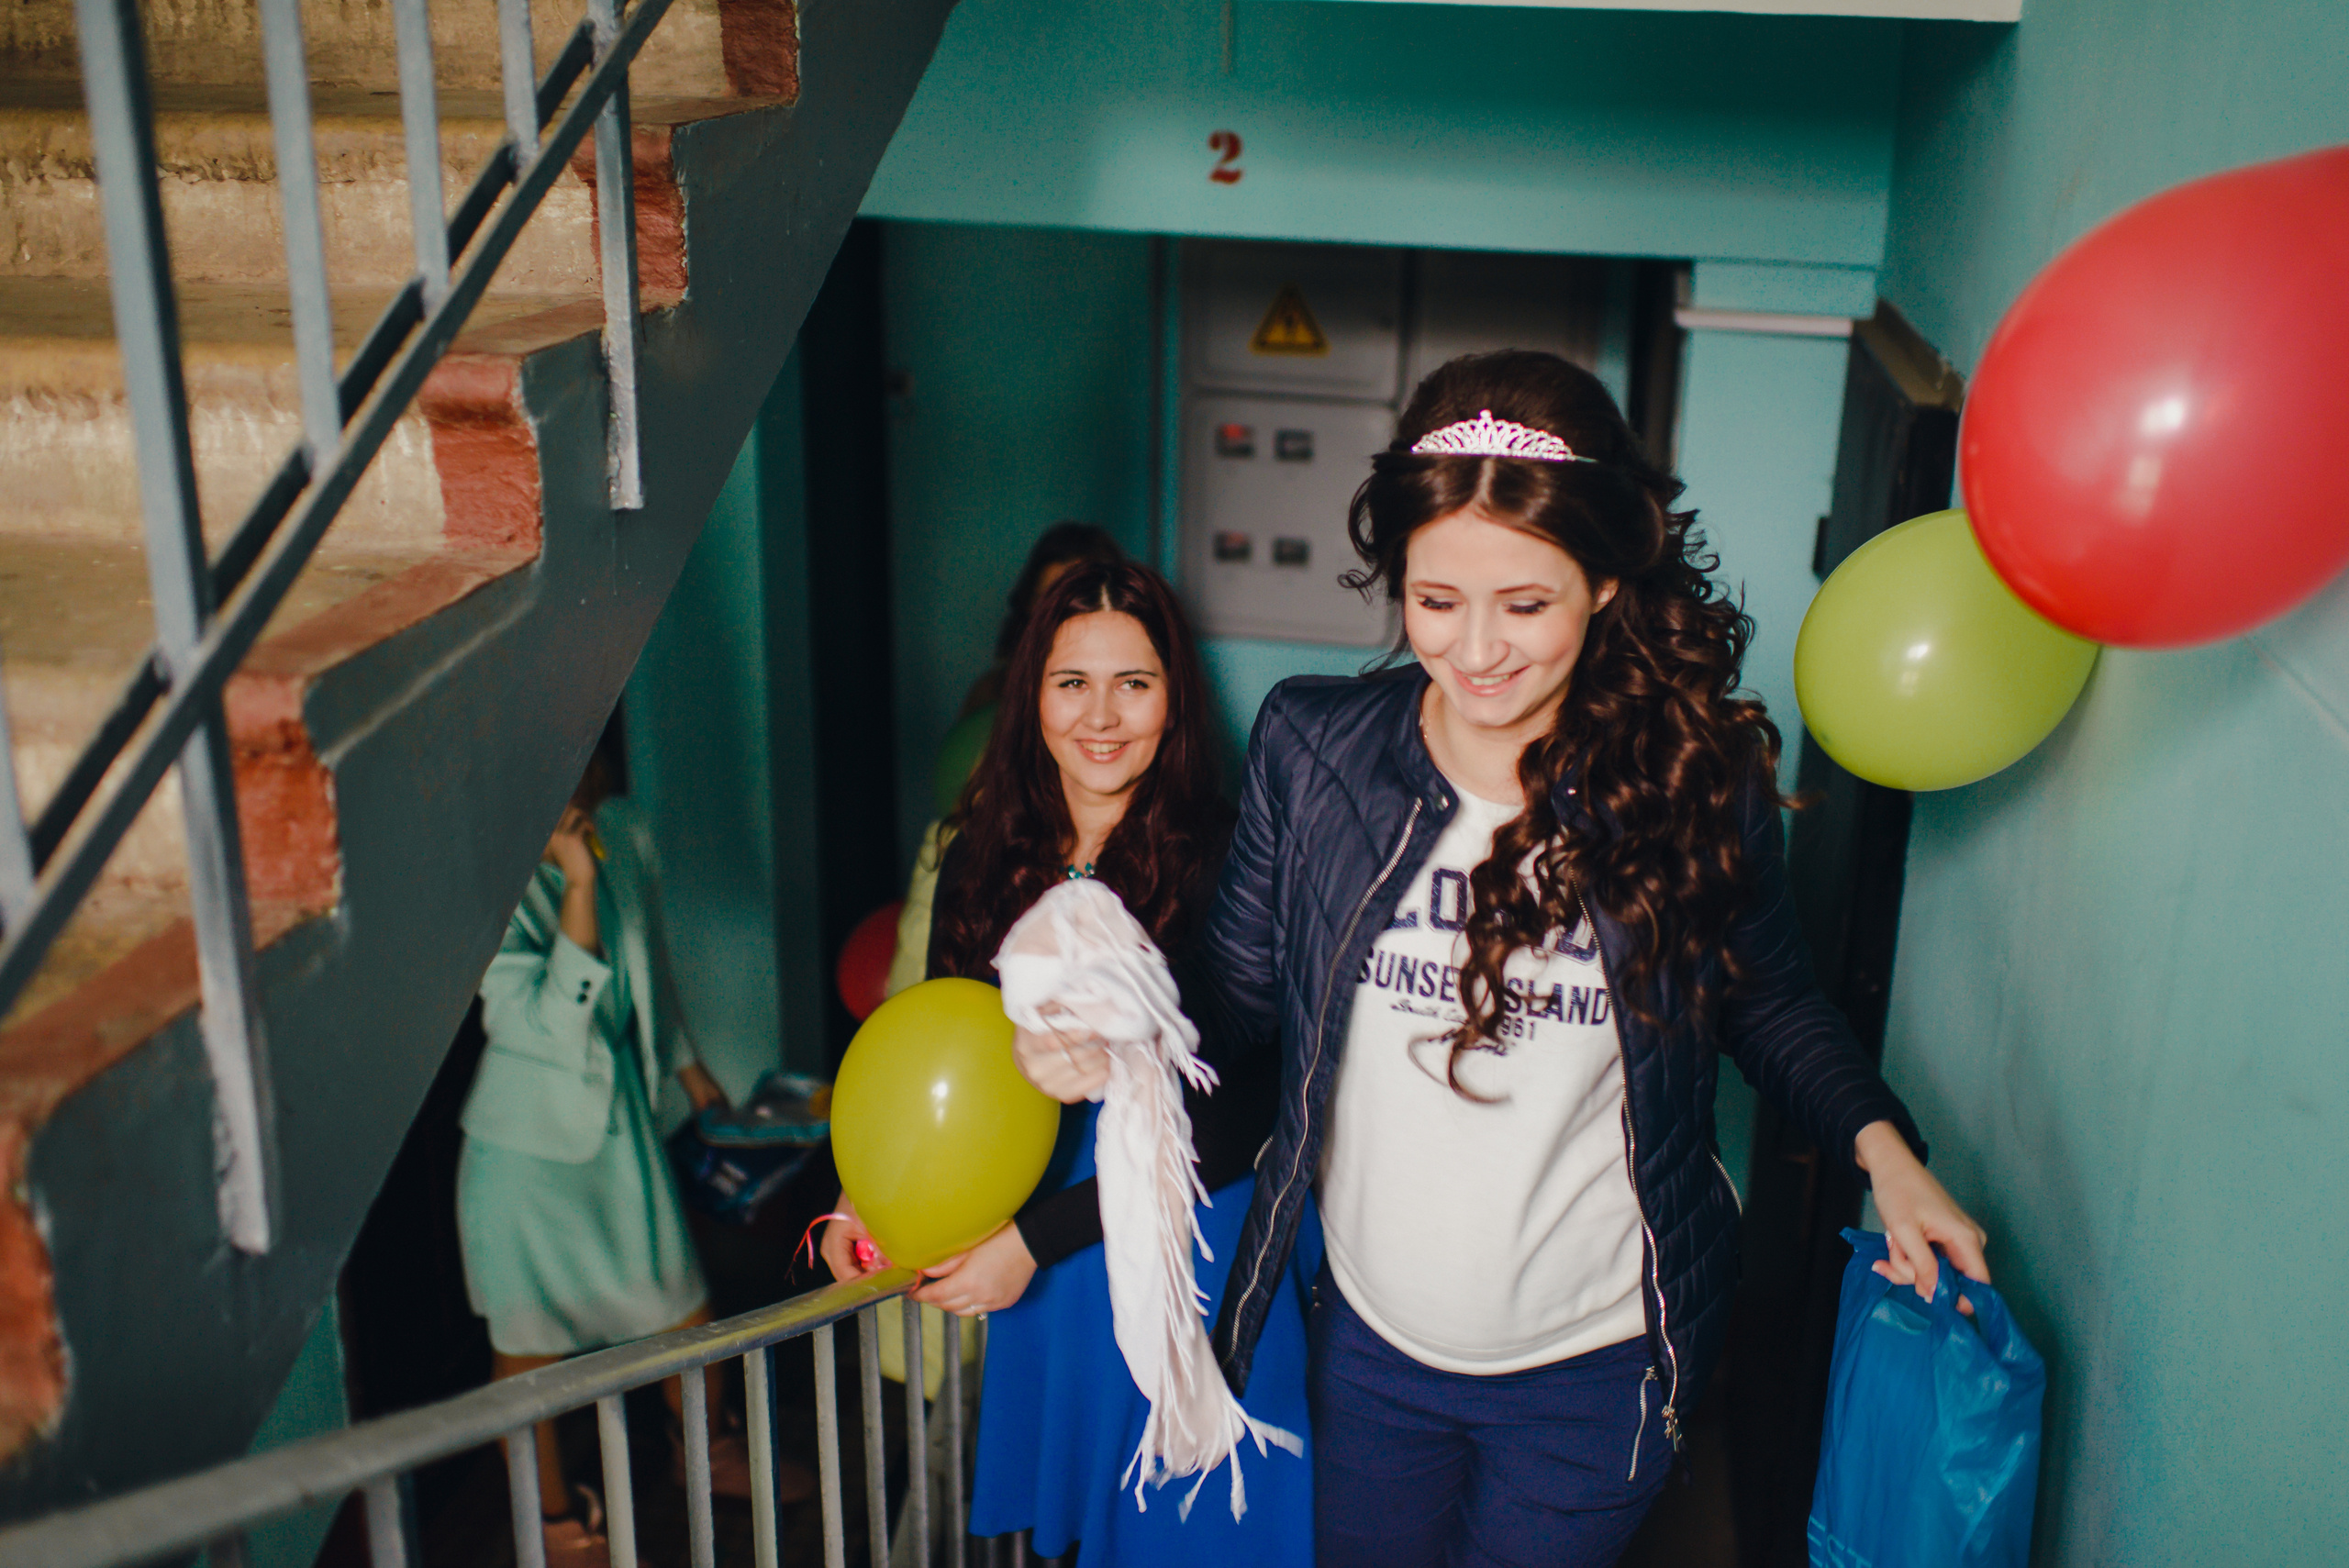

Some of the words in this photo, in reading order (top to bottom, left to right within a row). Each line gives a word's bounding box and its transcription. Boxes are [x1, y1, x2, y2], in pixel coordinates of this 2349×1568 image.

[1208, 129, 1243, 184] 2
[1356, 946, 1462, 1003] SUNSE
[1500, 977, 1609, 1026] SLAND
[1499, 1014, 1535, 1041] 961
